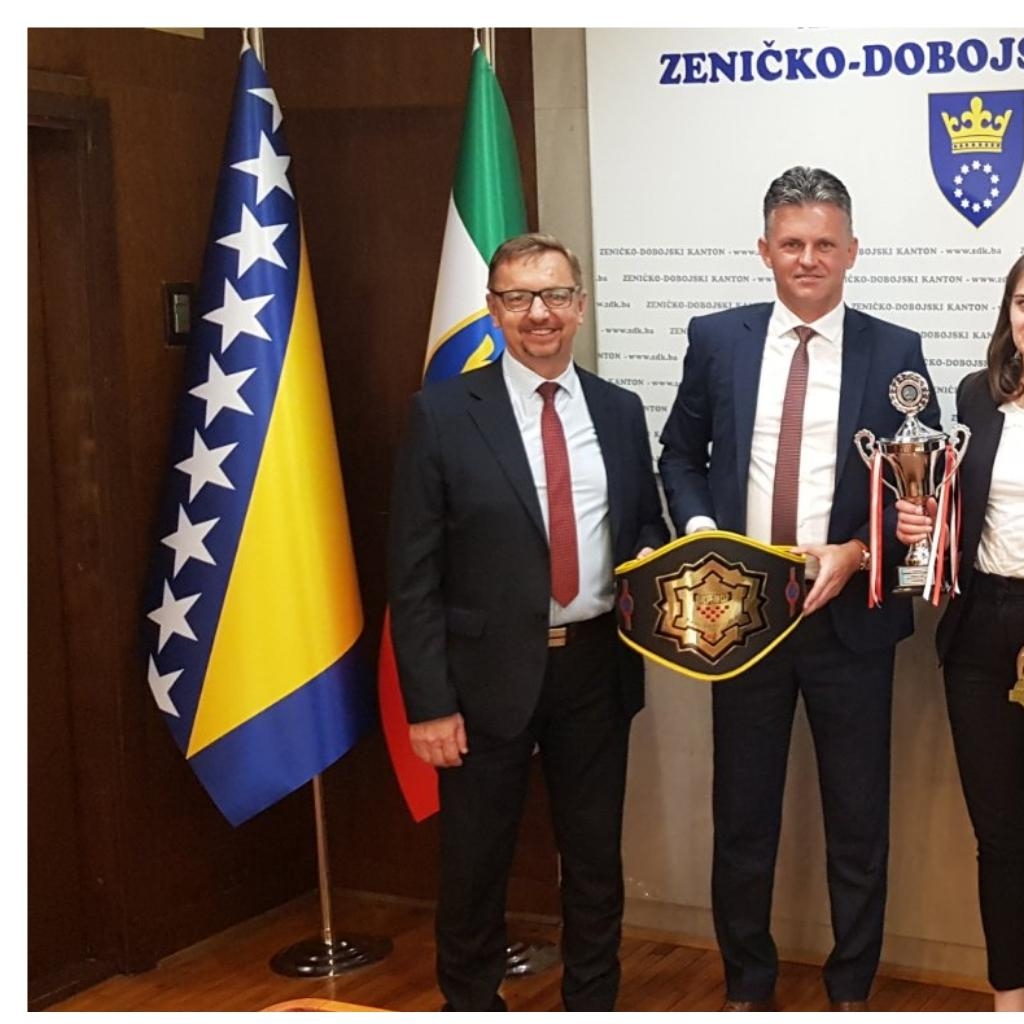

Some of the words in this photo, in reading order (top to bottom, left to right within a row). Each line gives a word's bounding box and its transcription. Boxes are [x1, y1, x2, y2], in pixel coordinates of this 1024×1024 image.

[687, 248, 726, 256] KANTON
[896, 247, 938, 255] KANTON
[945, 247, 1002, 255] www.zdk.ba
[711, 275, 749, 283] KANTON
[922, 275, 963, 283] KANTON
[947, 303, 989, 311] KANTON
